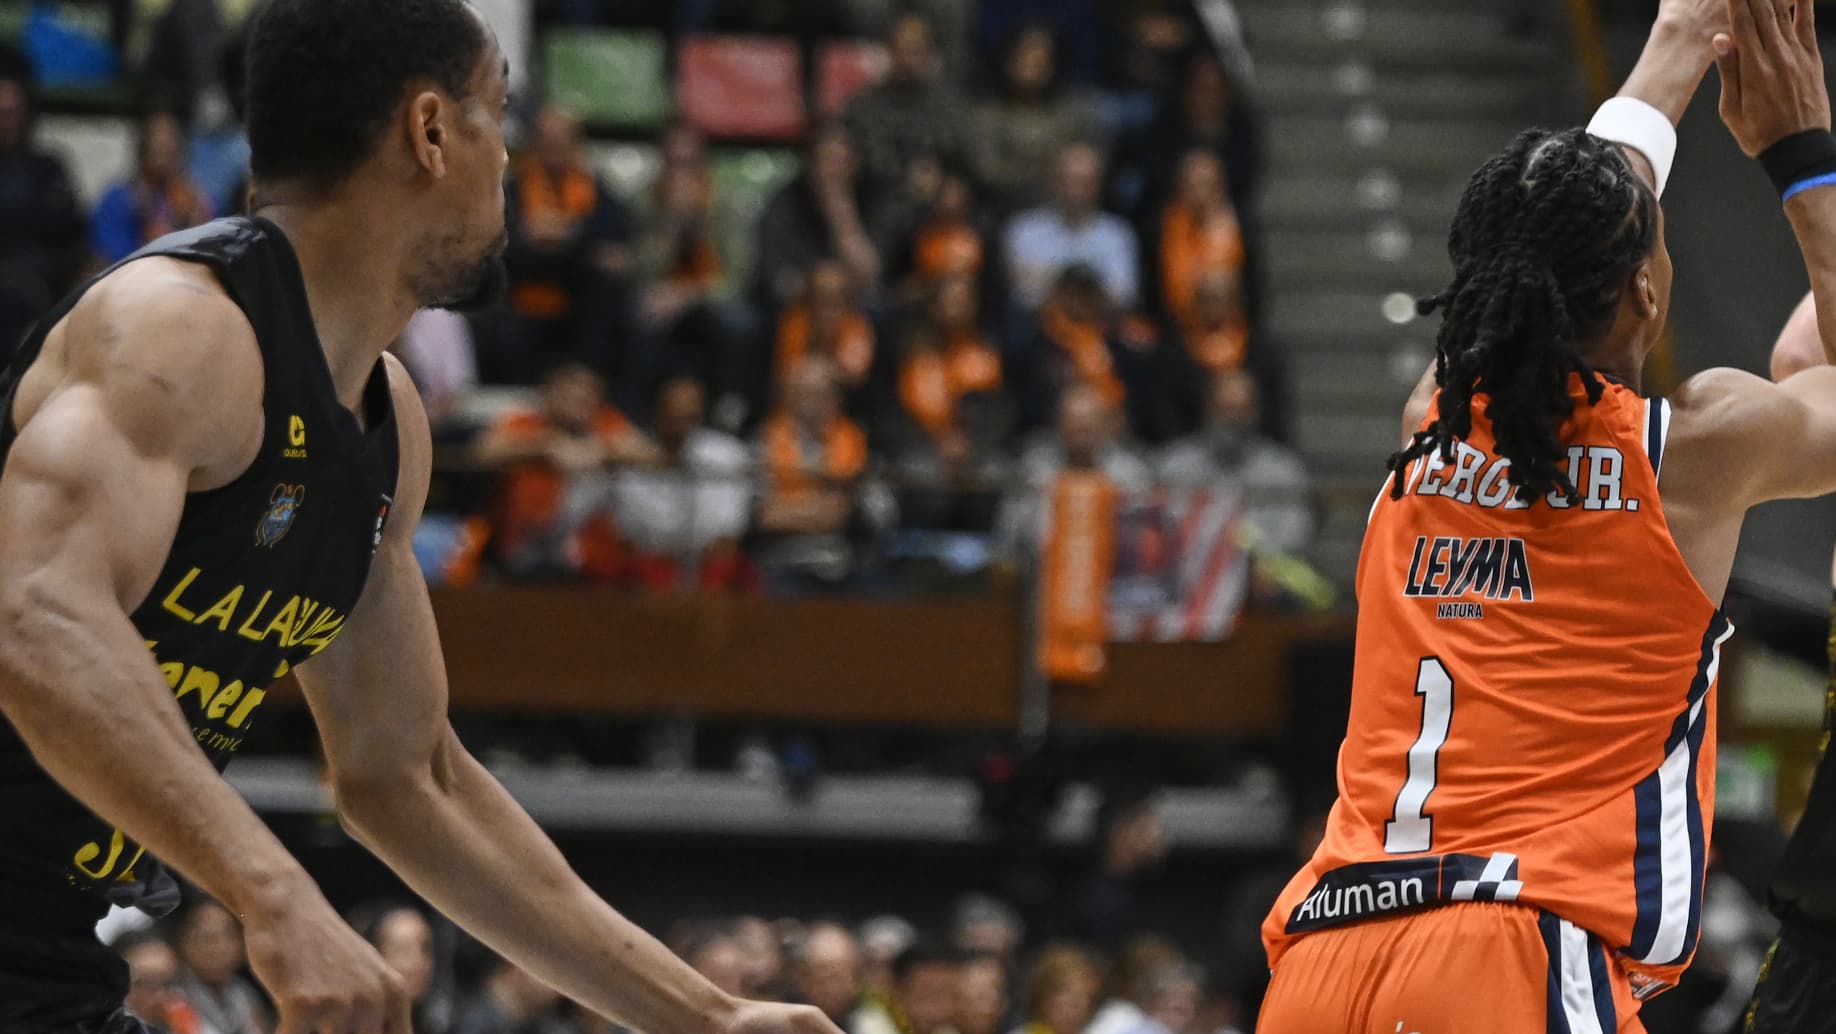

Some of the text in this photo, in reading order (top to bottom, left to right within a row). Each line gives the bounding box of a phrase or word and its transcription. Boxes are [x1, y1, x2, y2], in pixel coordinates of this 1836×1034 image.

[1405, 440, 1640, 512] ERG JR.
[162, 567, 245, 631] LA
[1402, 536, 1535, 603] LEYMA
[1436, 602, 1484, 620] NATURA
[1383, 655, 1454, 853] 1
[1296, 875, 1425, 922] Aluman
